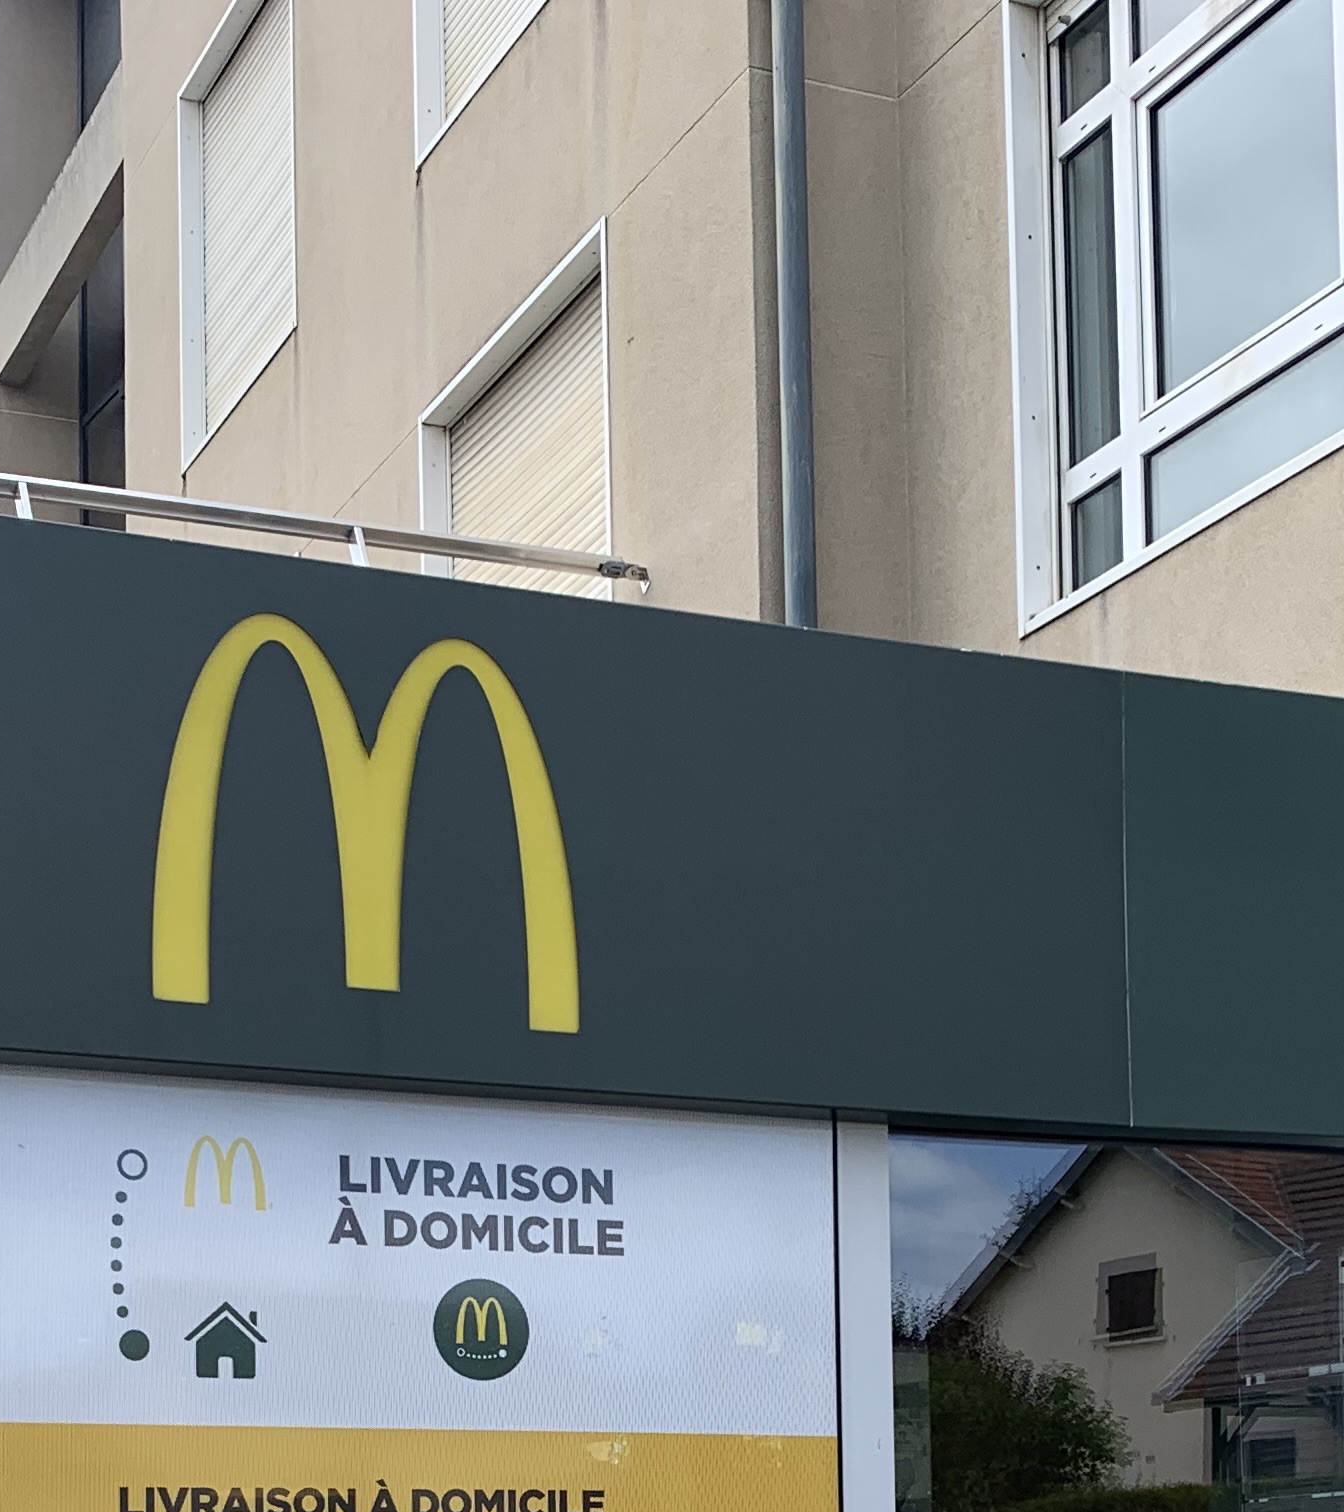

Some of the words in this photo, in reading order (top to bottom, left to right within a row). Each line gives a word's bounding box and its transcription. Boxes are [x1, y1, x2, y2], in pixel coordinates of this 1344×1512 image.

[338, 1154, 614, 1205] LIVRAISON
[328, 1196, 367, 1247] À
[383, 1207, 625, 1257] DOMICILE
